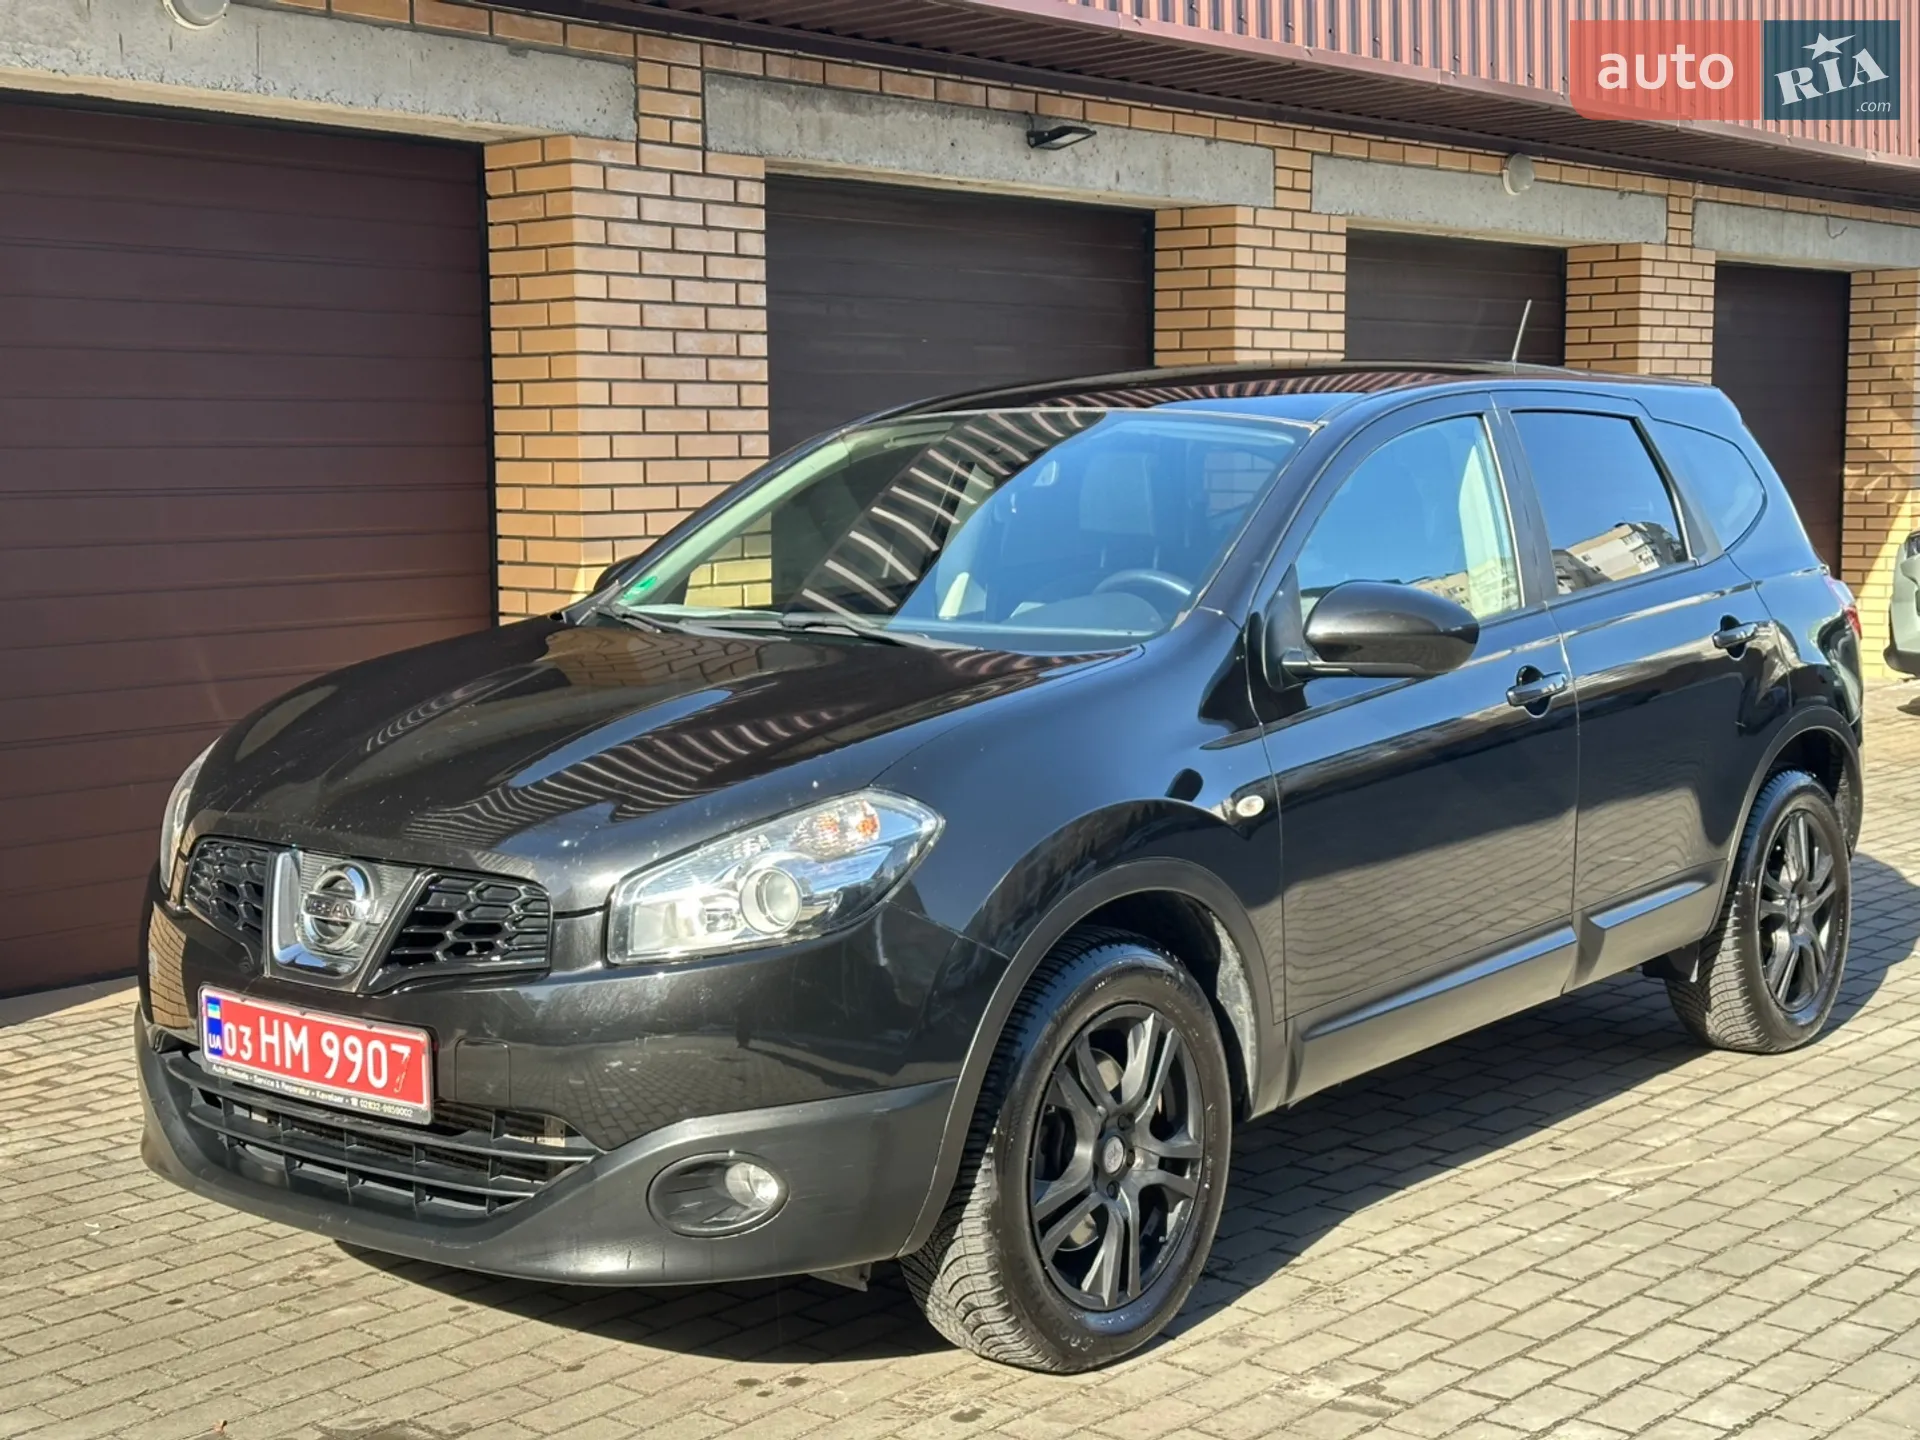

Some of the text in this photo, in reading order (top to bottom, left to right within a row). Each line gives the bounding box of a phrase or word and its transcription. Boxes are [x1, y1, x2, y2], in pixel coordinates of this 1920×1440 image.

[207, 1034, 223, 1050] UA
[223, 1015, 412, 1093] 03 HM 9907
